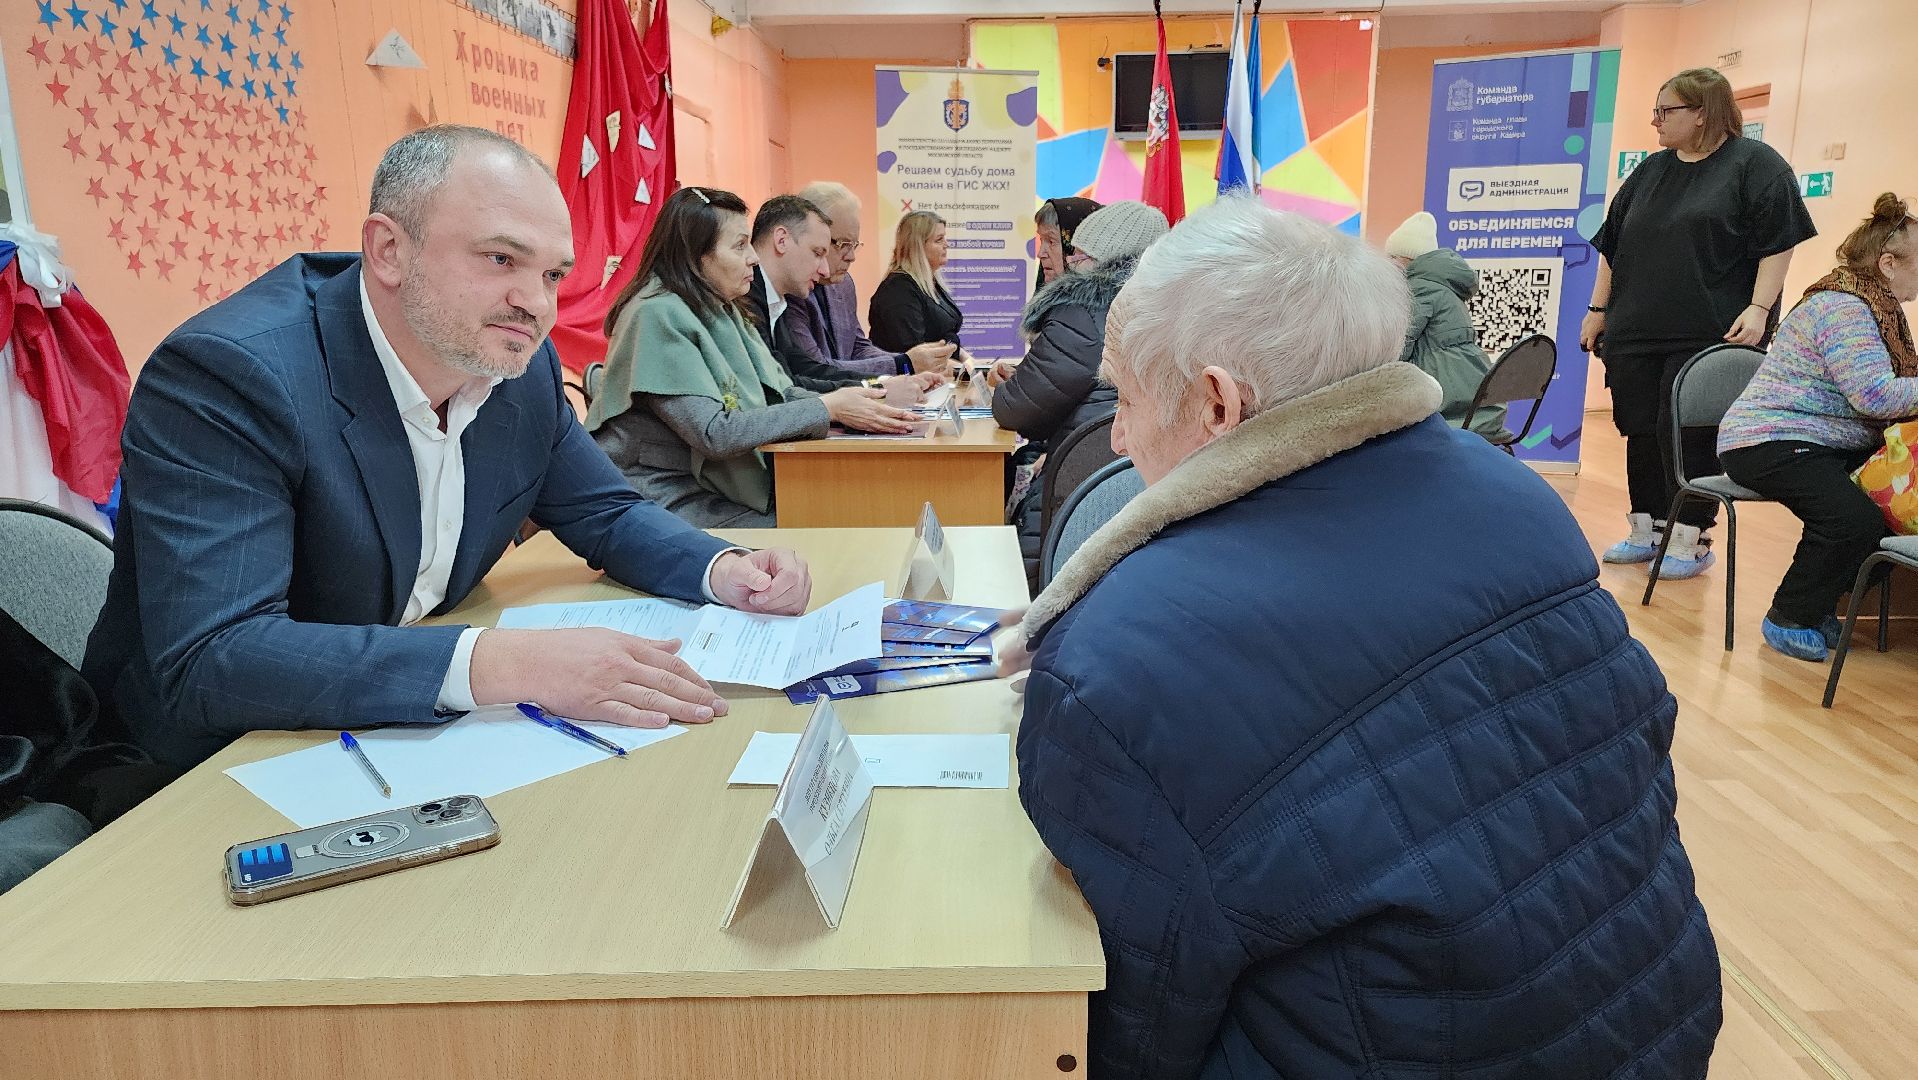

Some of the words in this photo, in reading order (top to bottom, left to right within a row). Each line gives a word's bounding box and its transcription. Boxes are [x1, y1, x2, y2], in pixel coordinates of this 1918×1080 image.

[453, 29, 539, 83] Хроника
[1477, 86, 1518, 95] Команда
[471, 81, 546, 119] военных
[1476, 93, 1534, 106] губернатора
[1472, 125, 1514, 133] городского
[1471, 133, 1497, 141] округа
[1500, 131, 1526, 139] Кашира
[897, 164, 941, 175] Решаем
[945, 166, 984, 178] судьбу
[987, 168, 1015, 177] дома
[902, 180, 944, 190] онлайн
[957, 180, 979, 190] ГИС
[982, 181, 1010, 191] ЖКХ!
[1490, 180, 1540, 188] ВЫЕЗДНАЯ
[1489, 187, 1569, 197] АДМИНИСТРАЦИЯ
[918, 202, 932, 210] Нет
[1448, 216, 1575, 232] ОБЪЕДИНЯЕМСЯ
[1455, 237, 1489, 251] ДЛЯ
[1491, 235, 1563, 249] ПЕРЕМЕН
